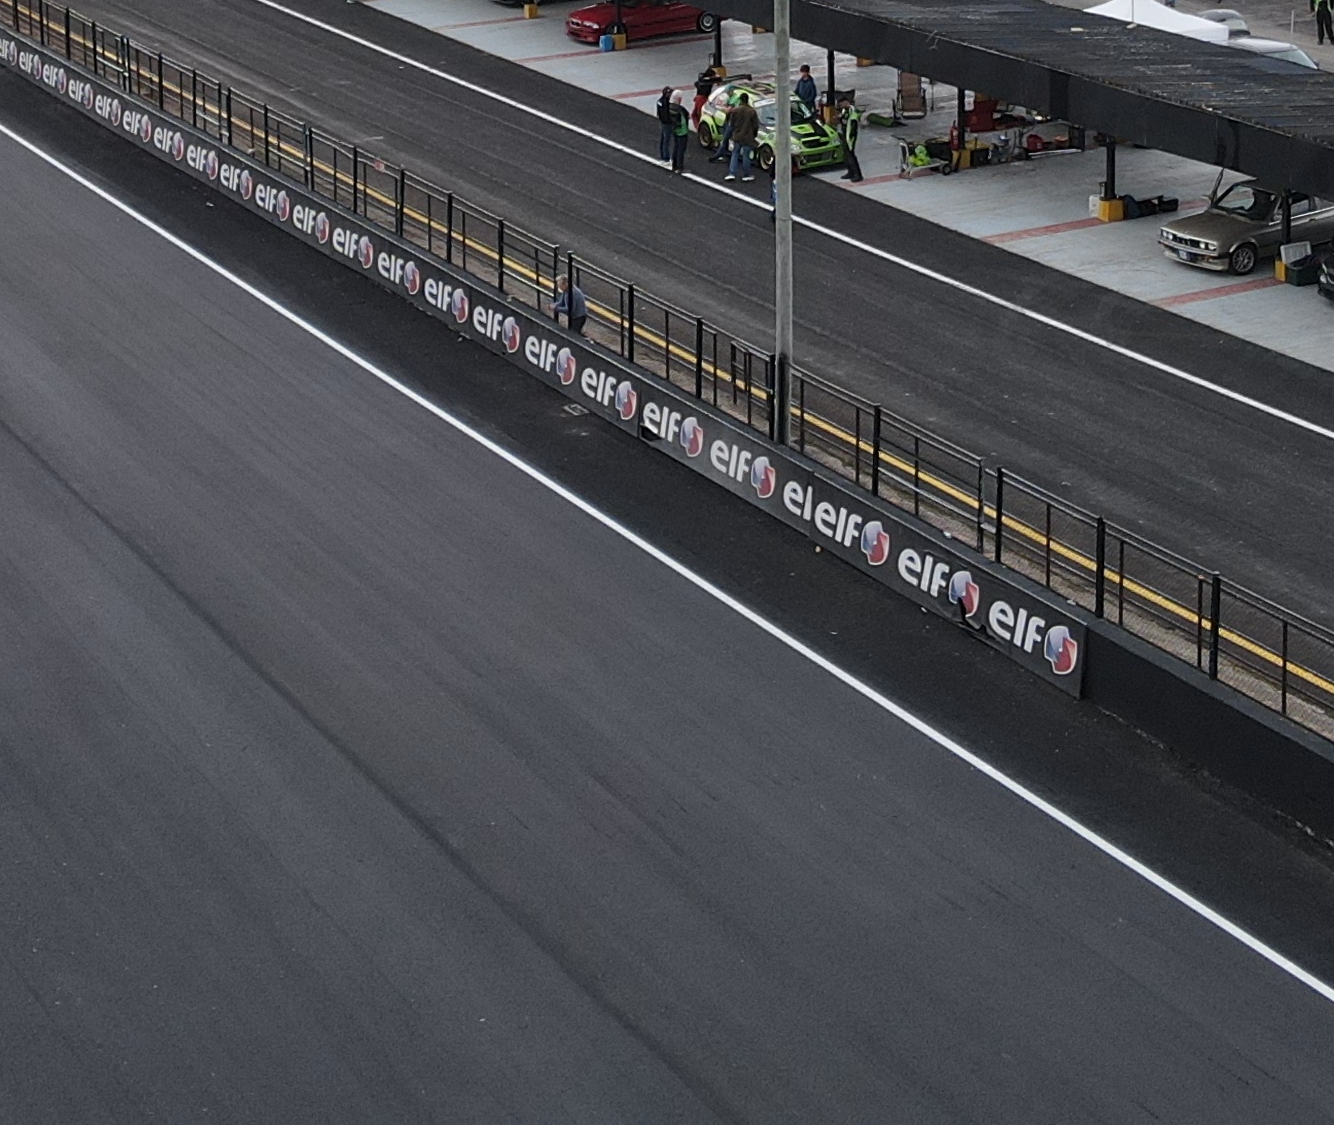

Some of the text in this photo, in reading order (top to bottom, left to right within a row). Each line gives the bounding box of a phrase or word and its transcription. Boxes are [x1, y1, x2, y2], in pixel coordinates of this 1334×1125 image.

[19, 52, 33, 74] elf
[43, 64, 58, 87] elf
[68, 79, 84, 103] elf
[95, 95, 112, 119] elf
[122, 110, 141, 135] elf
[153, 127, 173, 153] elf
[186, 145, 207, 171] elf
[220, 164, 240, 191] elf
[255, 183, 279, 214] elf
[293, 204, 316, 235] elf
[332, 227, 358, 257] elf
[377, 251, 404, 285] elf
[424, 276, 452, 313] elf
[473, 305, 502, 342] elf
[525, 335, 556, 372] elf
[581, 367, 616, 406] elf
[642, 401, 681, 442] elf
[710, 439, 751, 483] elf
[783, 479, 812, 521] el
[814, 505, 862, 548] elf
[898, 547, 950, 598] elf
[989, 600, 1045, 653] elf
